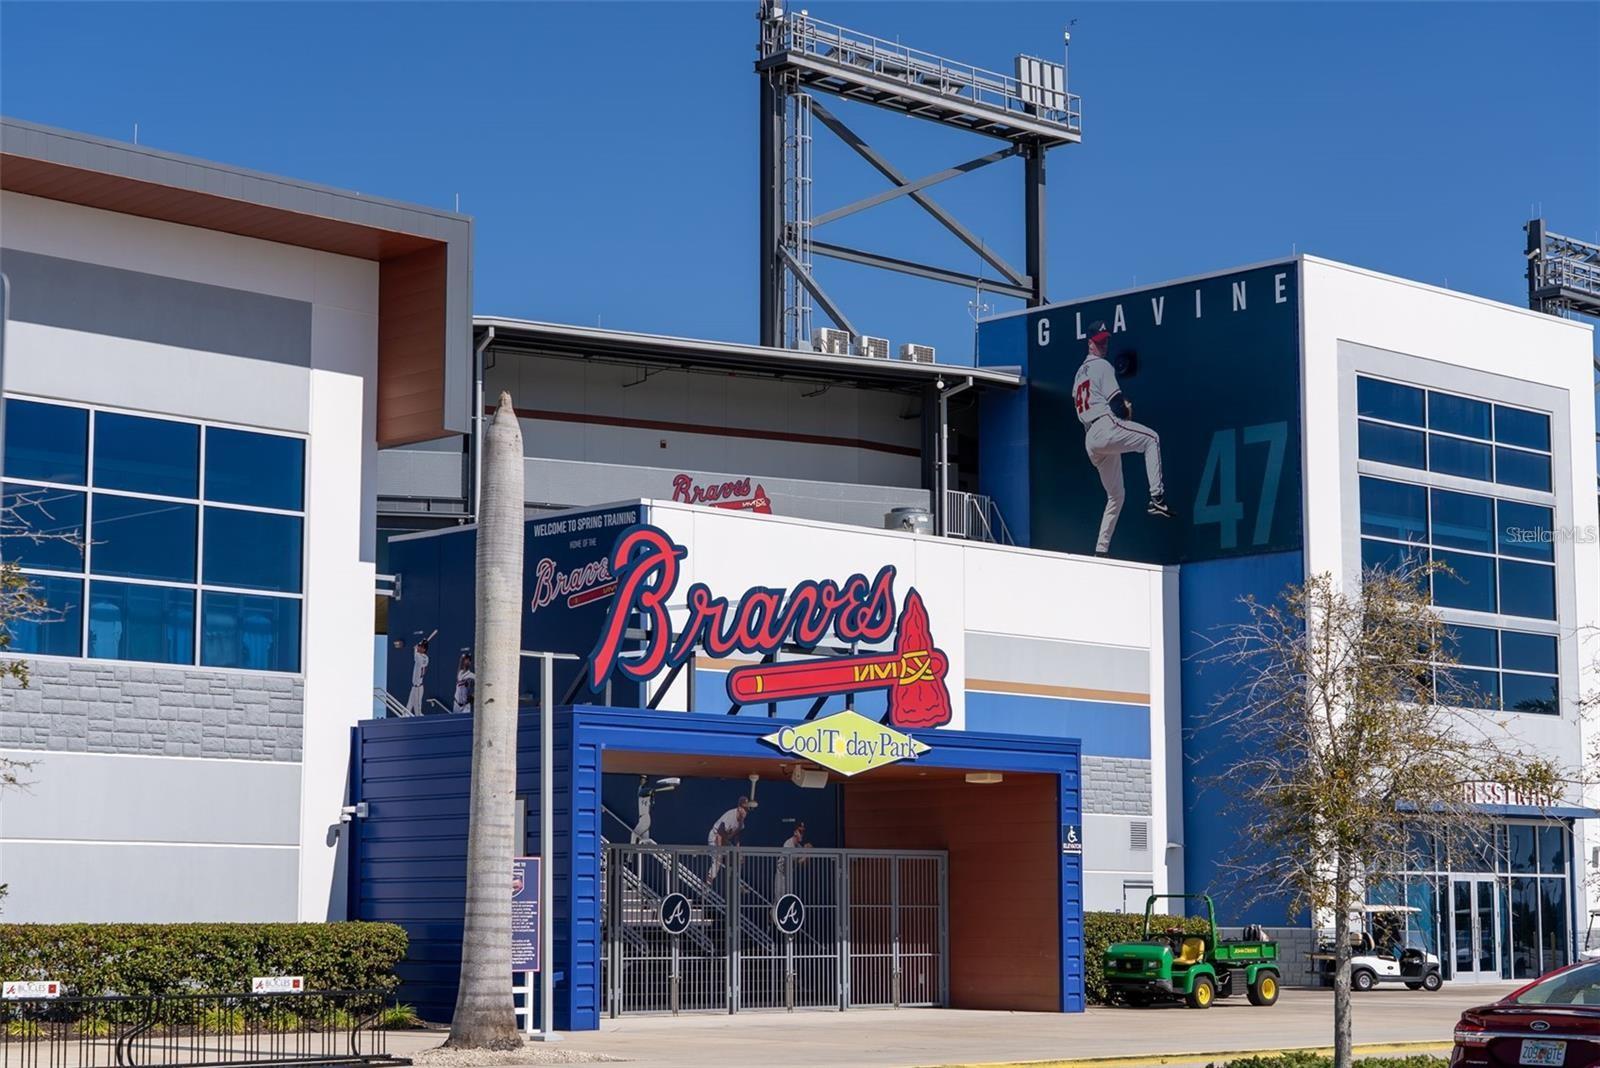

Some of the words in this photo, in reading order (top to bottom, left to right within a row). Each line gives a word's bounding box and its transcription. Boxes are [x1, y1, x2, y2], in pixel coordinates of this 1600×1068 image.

[1037, 273, 1287, 346] GLAVINE
[1076, 379, 1091, 415] 47
[672, 474, 751, 504] Braves
[1193, 420, 1288, 549] 47
[533, 520, 567, 537] WELCOME
[568, 519, 577, 532] TO
[577, 515, 603, 531] SPRING
[604, 511, 637, 527] TRAINING
[569, 539, 582, 549] HOME
[582, 539, 588, 547] OF
[588, 537, 597, 546] THE
[531, 557, 613, 613] Brave
[589, 524, 897, 693] Braves
